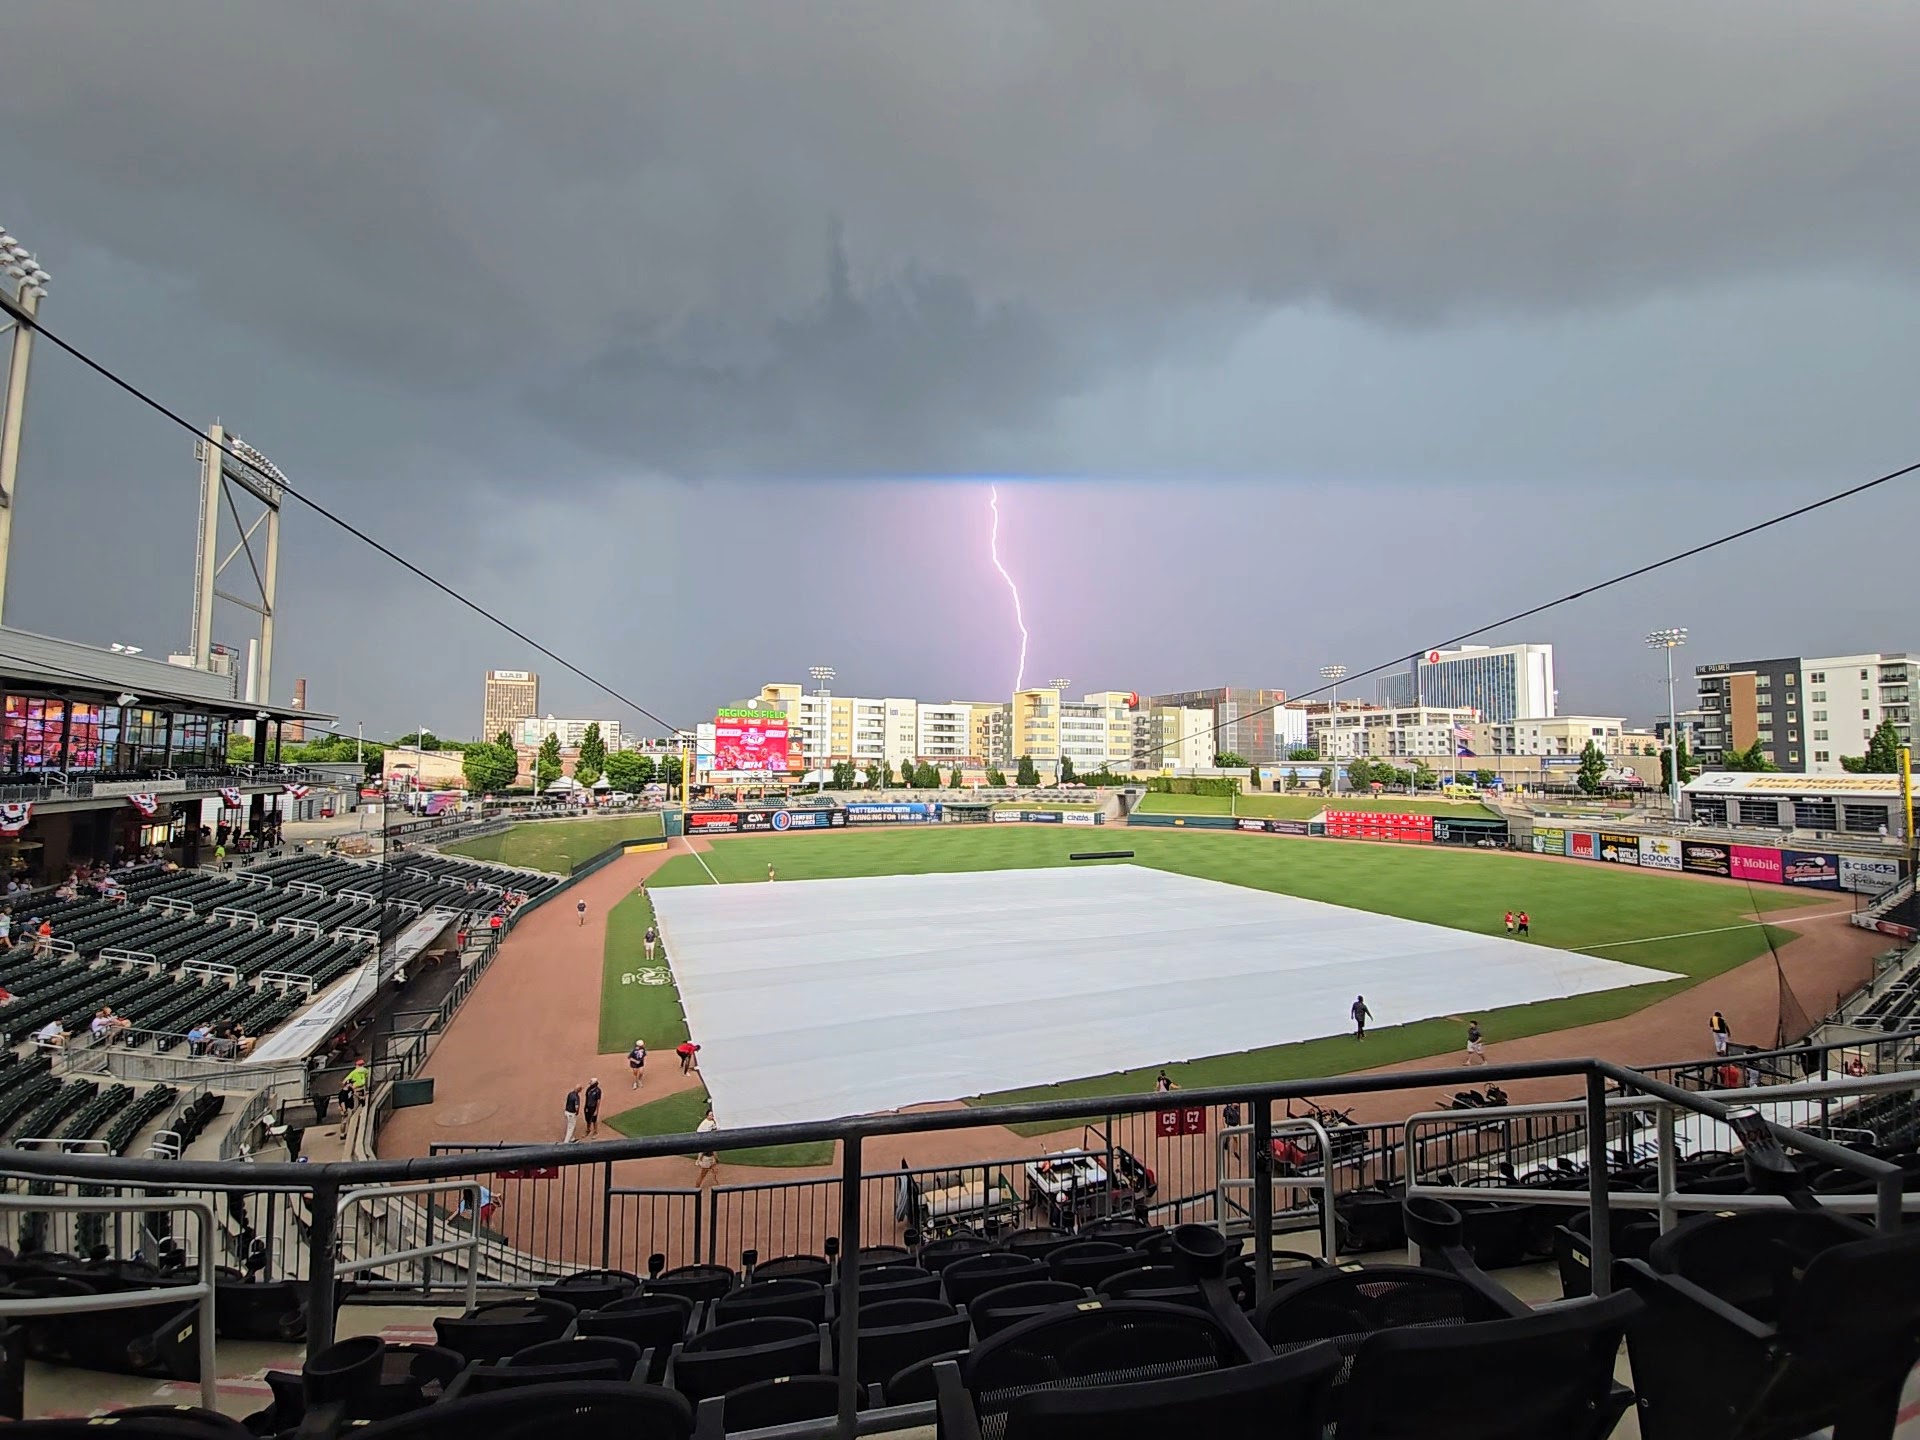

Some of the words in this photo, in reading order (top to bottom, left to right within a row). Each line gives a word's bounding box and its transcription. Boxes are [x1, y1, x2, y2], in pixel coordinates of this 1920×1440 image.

[1708, 663, 1730, 672] PALMER
[718, 708, 759, 718] REGIONS
[761, 710, 786, 719] FIELD
[848, 806, 893, 814] WETTERMARK
[1327, 811, 1378, 819] CHAMPIONS
[1618, 850, 1638, 859] WILD
[1641, 853, 1681, 865] COOK'S
[1743, 858, 1780, 871] Mobile
[1163, 1112, 1176, 1125] C6
[1187, 1111, 1200, 1123] C7
